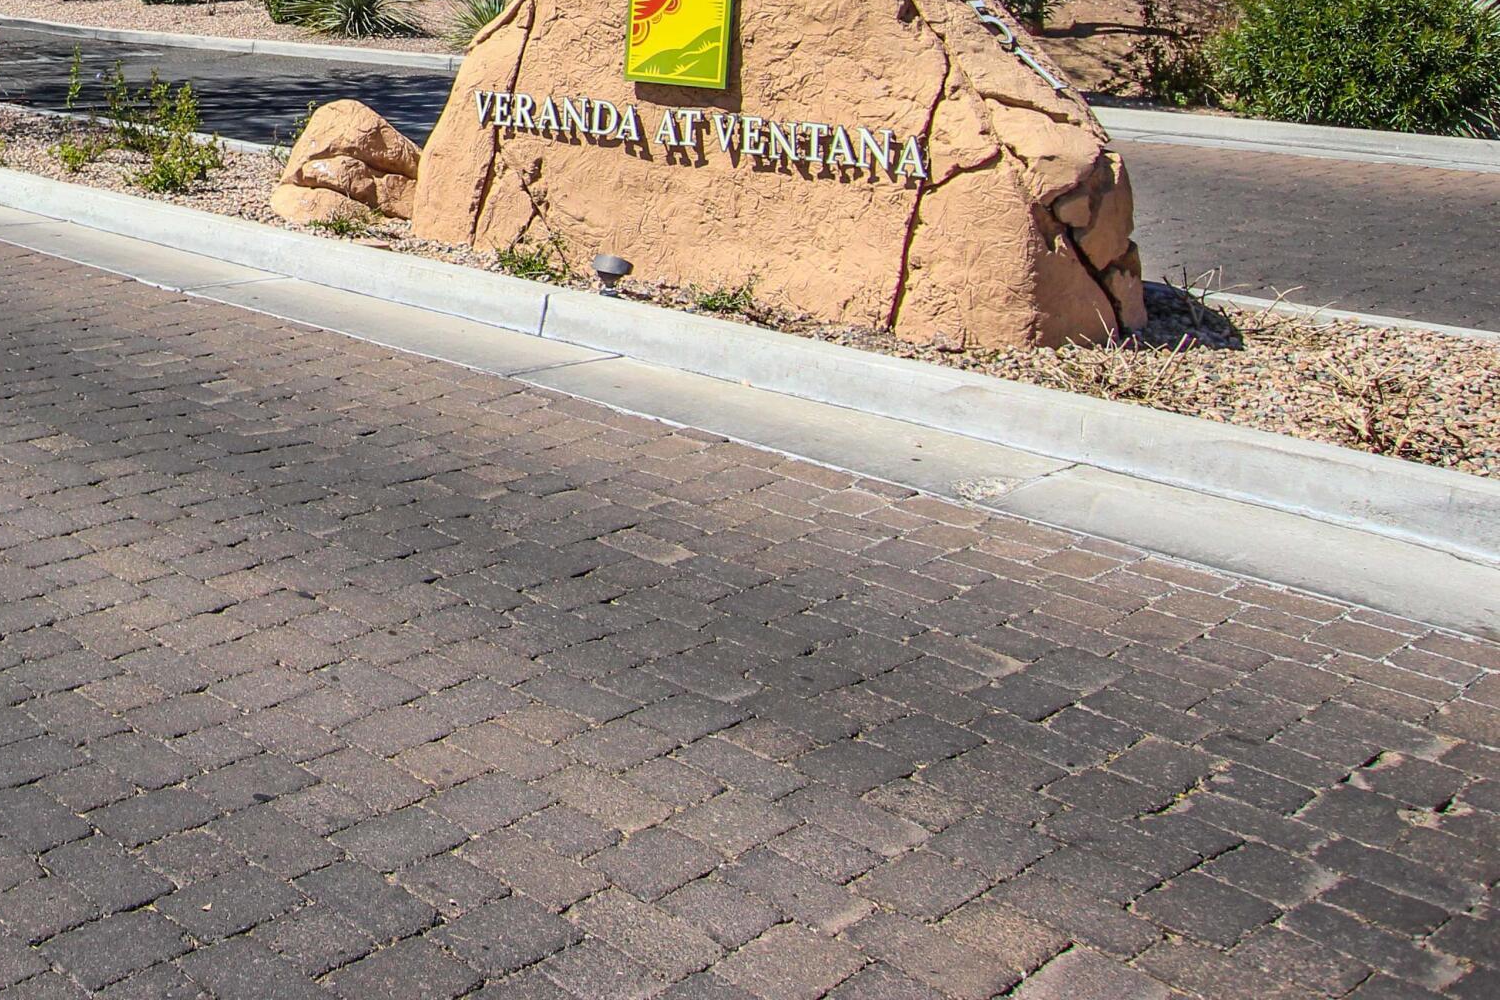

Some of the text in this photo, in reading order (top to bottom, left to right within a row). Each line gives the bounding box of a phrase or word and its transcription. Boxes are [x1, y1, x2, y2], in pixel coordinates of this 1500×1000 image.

[474, 89, 927, 179] VERANDA AT VENTANA
